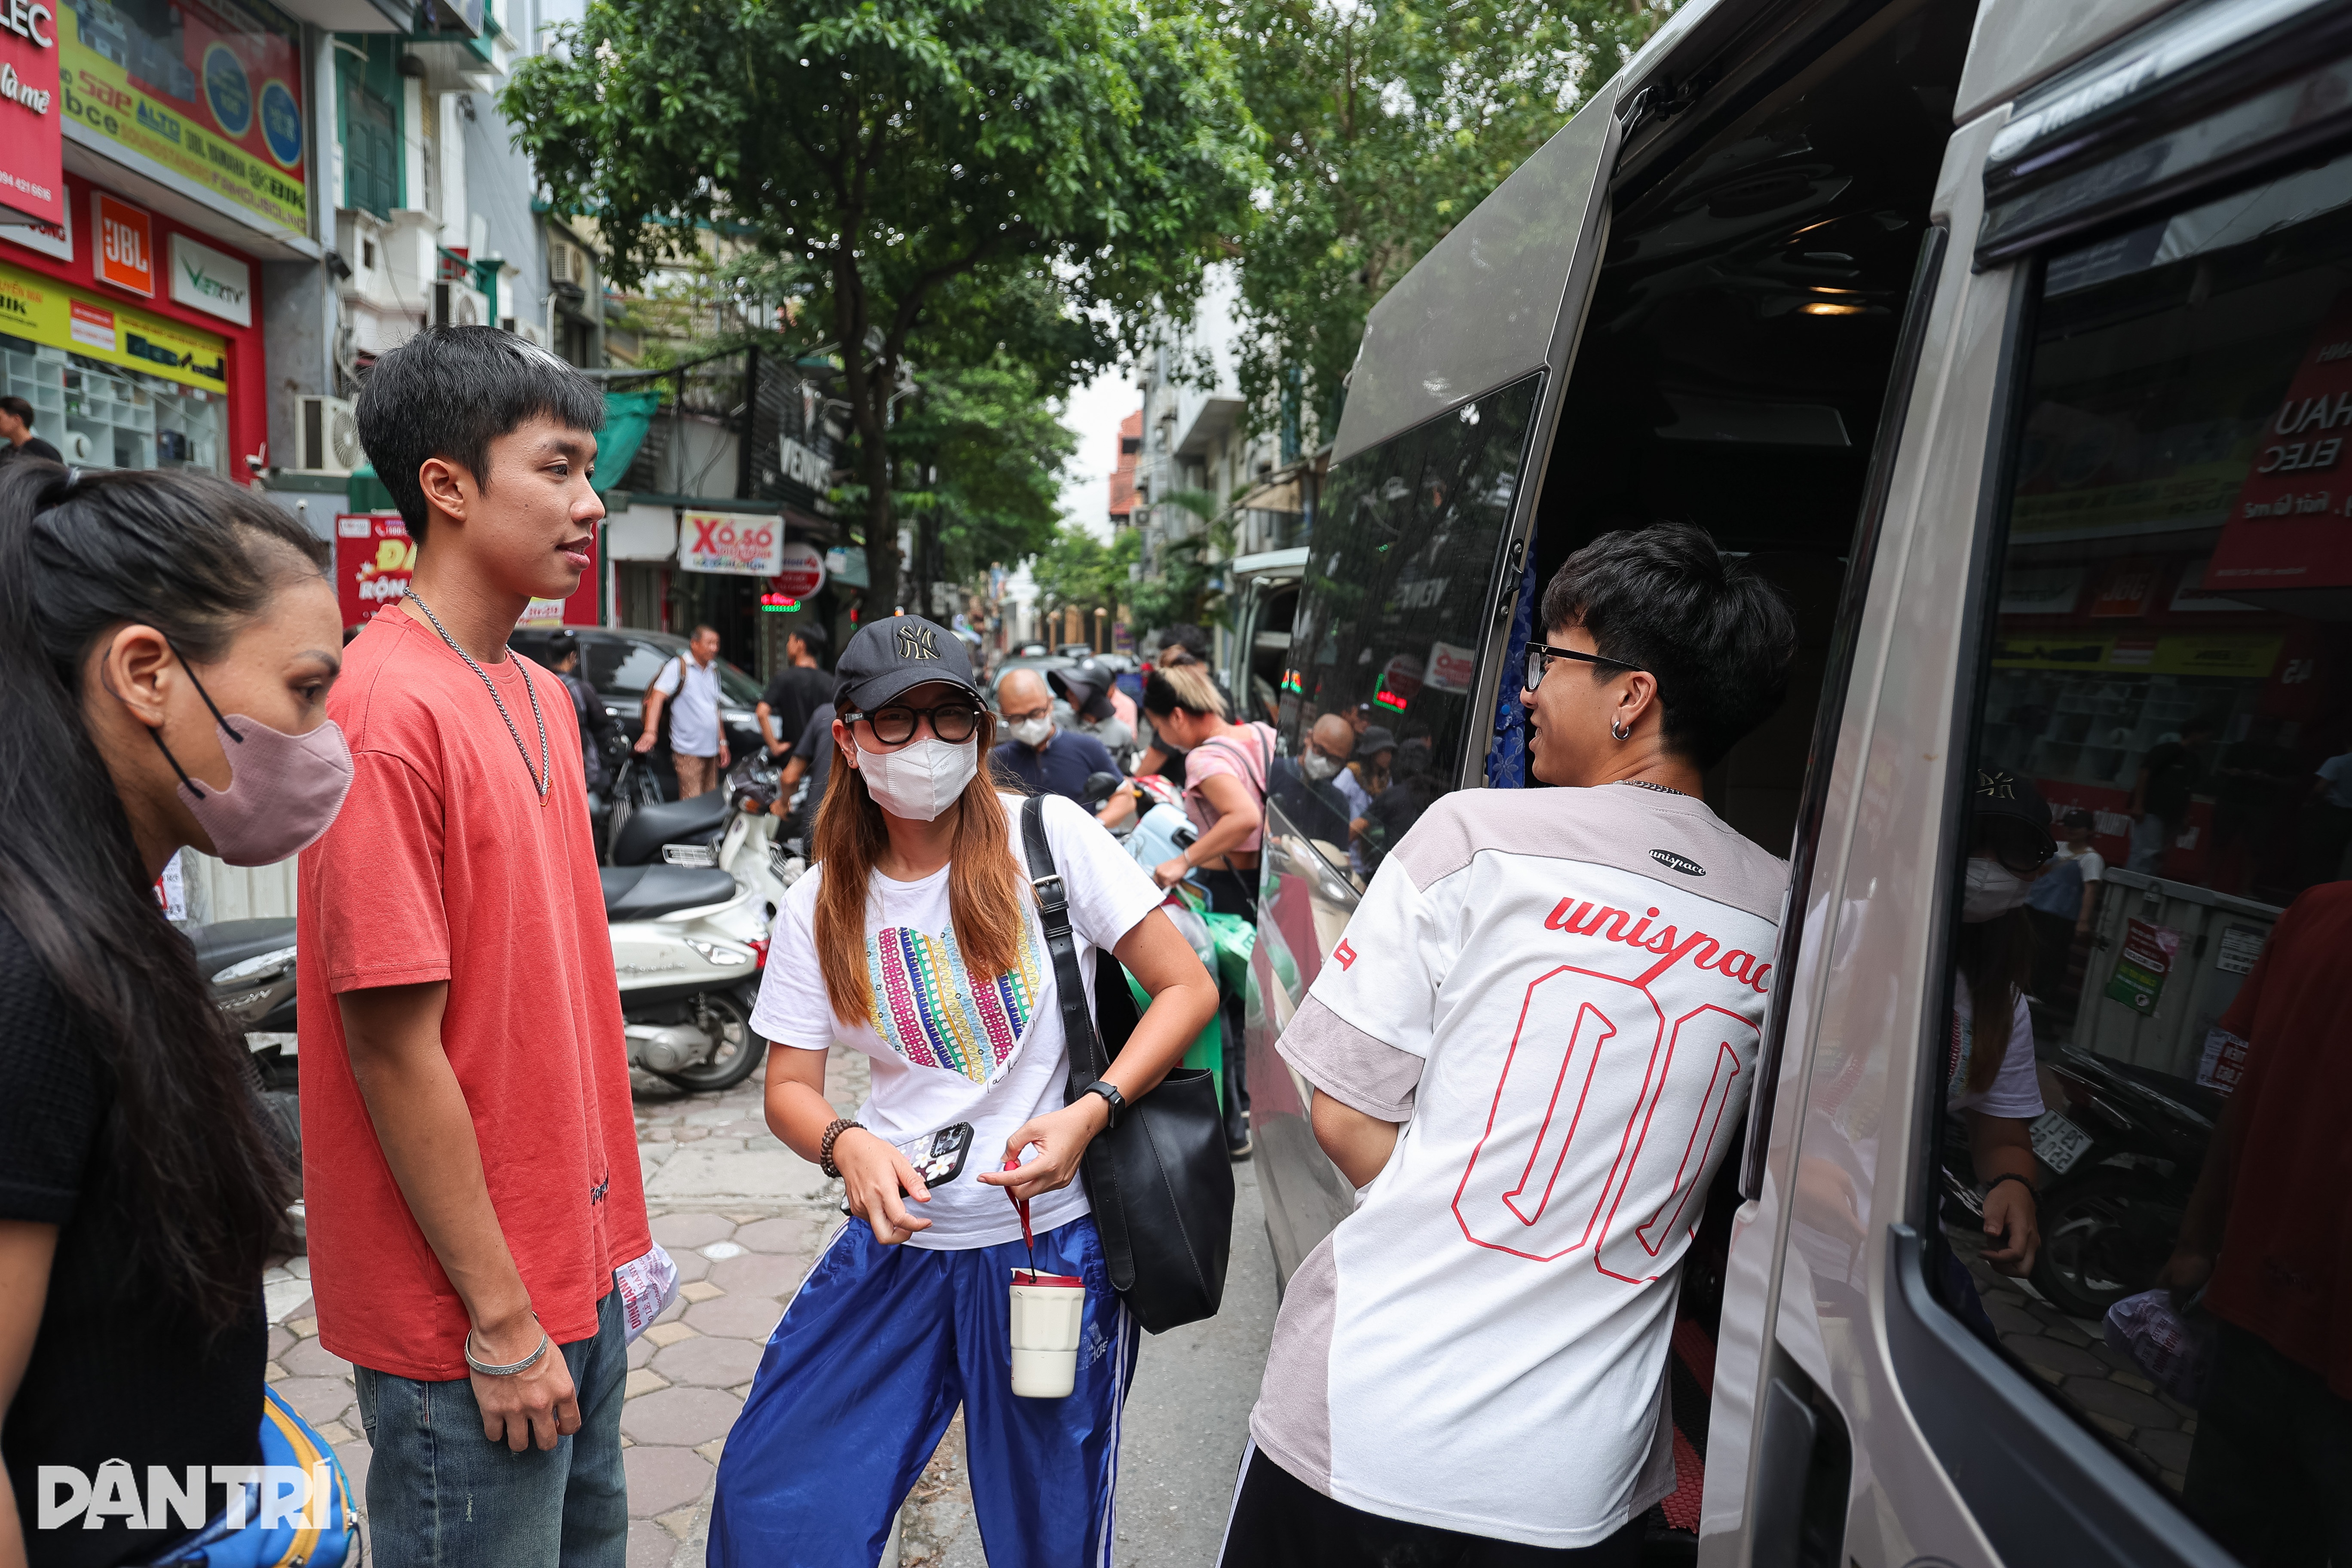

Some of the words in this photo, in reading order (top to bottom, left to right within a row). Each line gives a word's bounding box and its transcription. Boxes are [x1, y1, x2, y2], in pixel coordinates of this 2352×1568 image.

[104, 219, 148, 274] JBL
[1649, 849, 1706, 875] unispace
[1545, 897, 1773, 993] unispac
